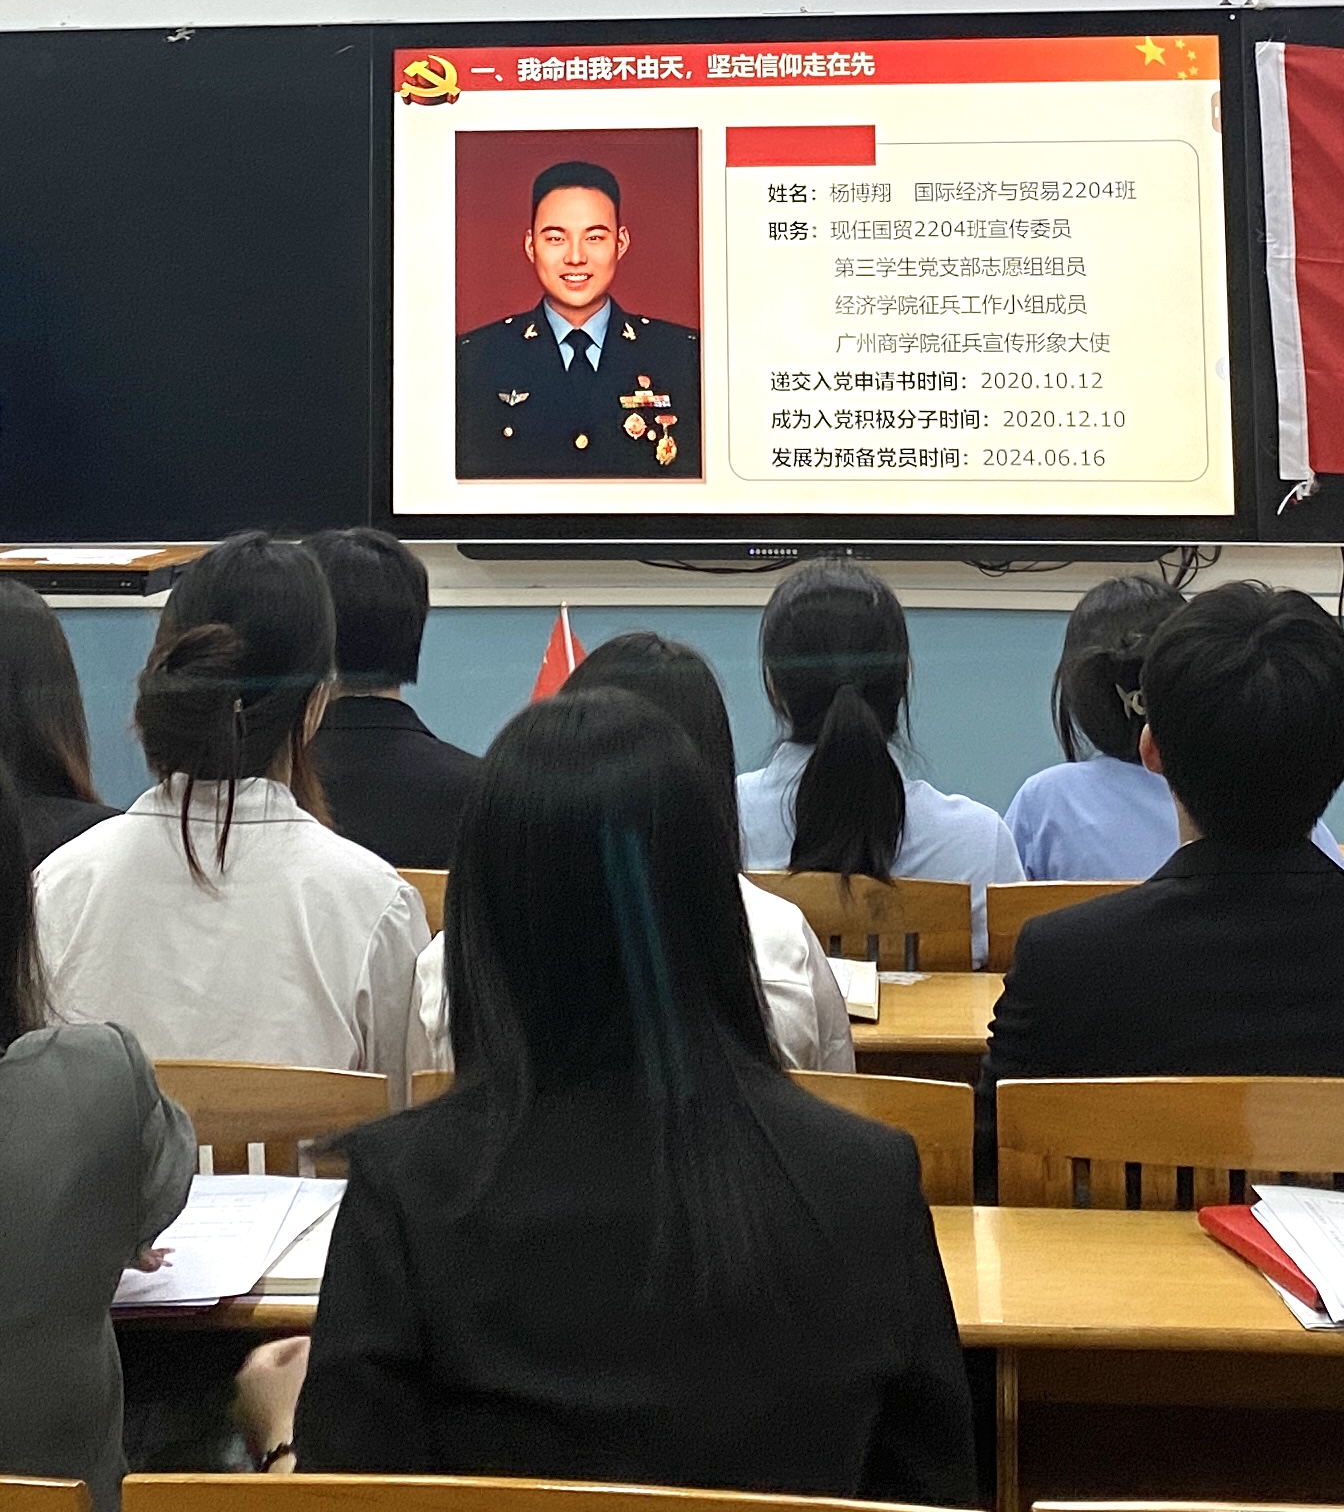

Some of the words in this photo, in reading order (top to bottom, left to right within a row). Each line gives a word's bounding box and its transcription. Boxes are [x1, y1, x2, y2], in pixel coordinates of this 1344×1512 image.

[470, 52, 876, 83] 一、我命由我不由天，坚定信仰走在先
[913, 180, 1138, 203] 国际经济与贸易2204班
[768, 218, 1072, 241] 职务：现任国贸2204班宣传委员
[834, 255, 1087, 278] 第三学生党支部志愿组组员
[834, 293, 1088, 316] 经济学院征兵工作小组成员
[835, 331, 1111, 354] 广州商学院征兵宣传形象大使
